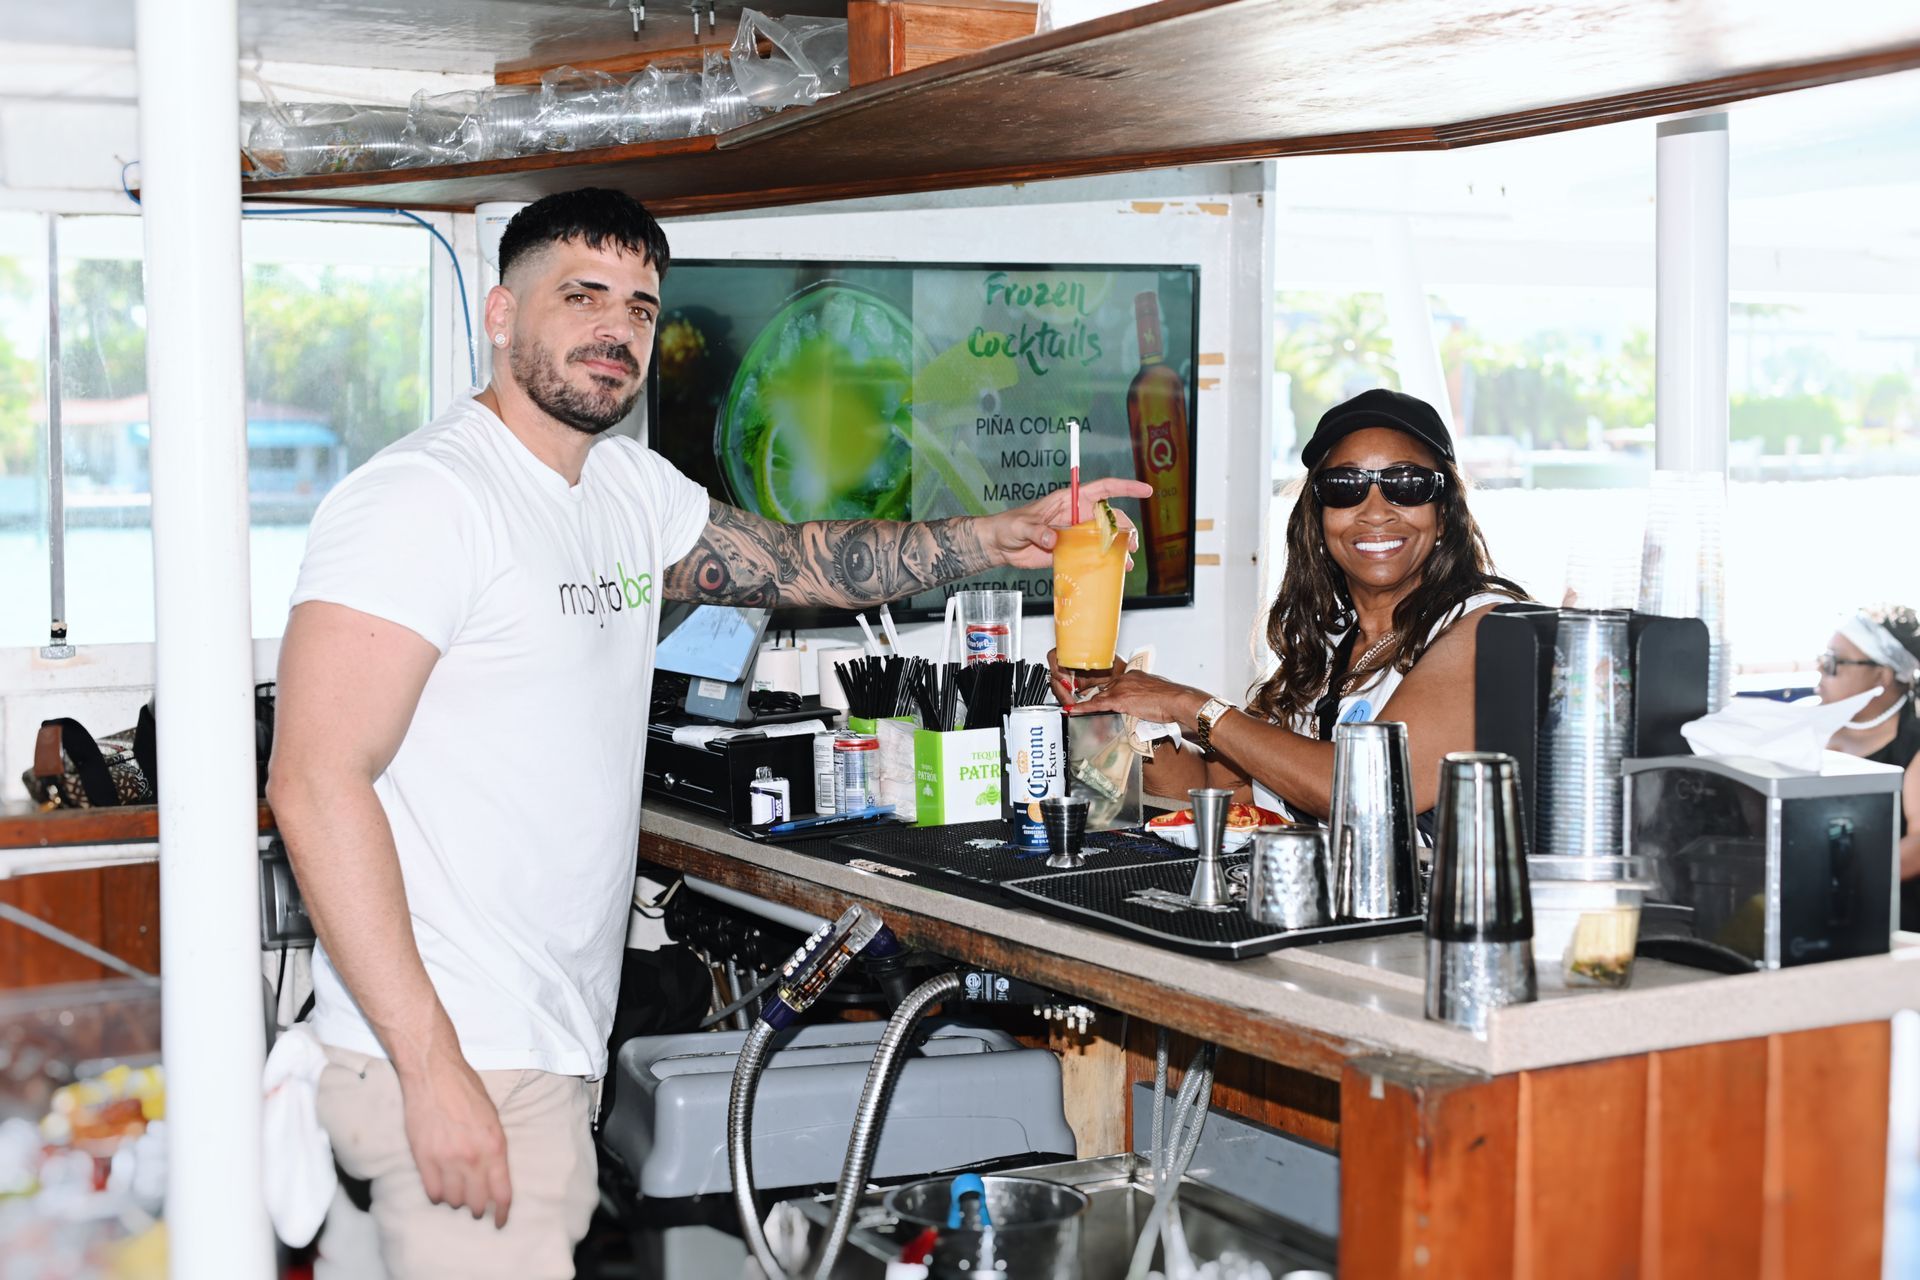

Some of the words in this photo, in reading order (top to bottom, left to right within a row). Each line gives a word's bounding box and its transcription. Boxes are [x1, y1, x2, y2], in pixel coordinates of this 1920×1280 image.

[984, 271, 1089, 317] Frozen
[968, 317, 1102, 376] Cocktails
[976, 415, 1015, 436] PIÑA
[1001, 449, 1067, 468] MOJITO
[1151, 438, 1172, 468] Q
[984, 481, 1072, 501] MARGART
[972, 751, 1000, 761] TEQUI
[1027, 726, 1050, 798] Corona
[1046, 742, 1057, 777] Extra
[960, 764, 1000, 780] PATR
